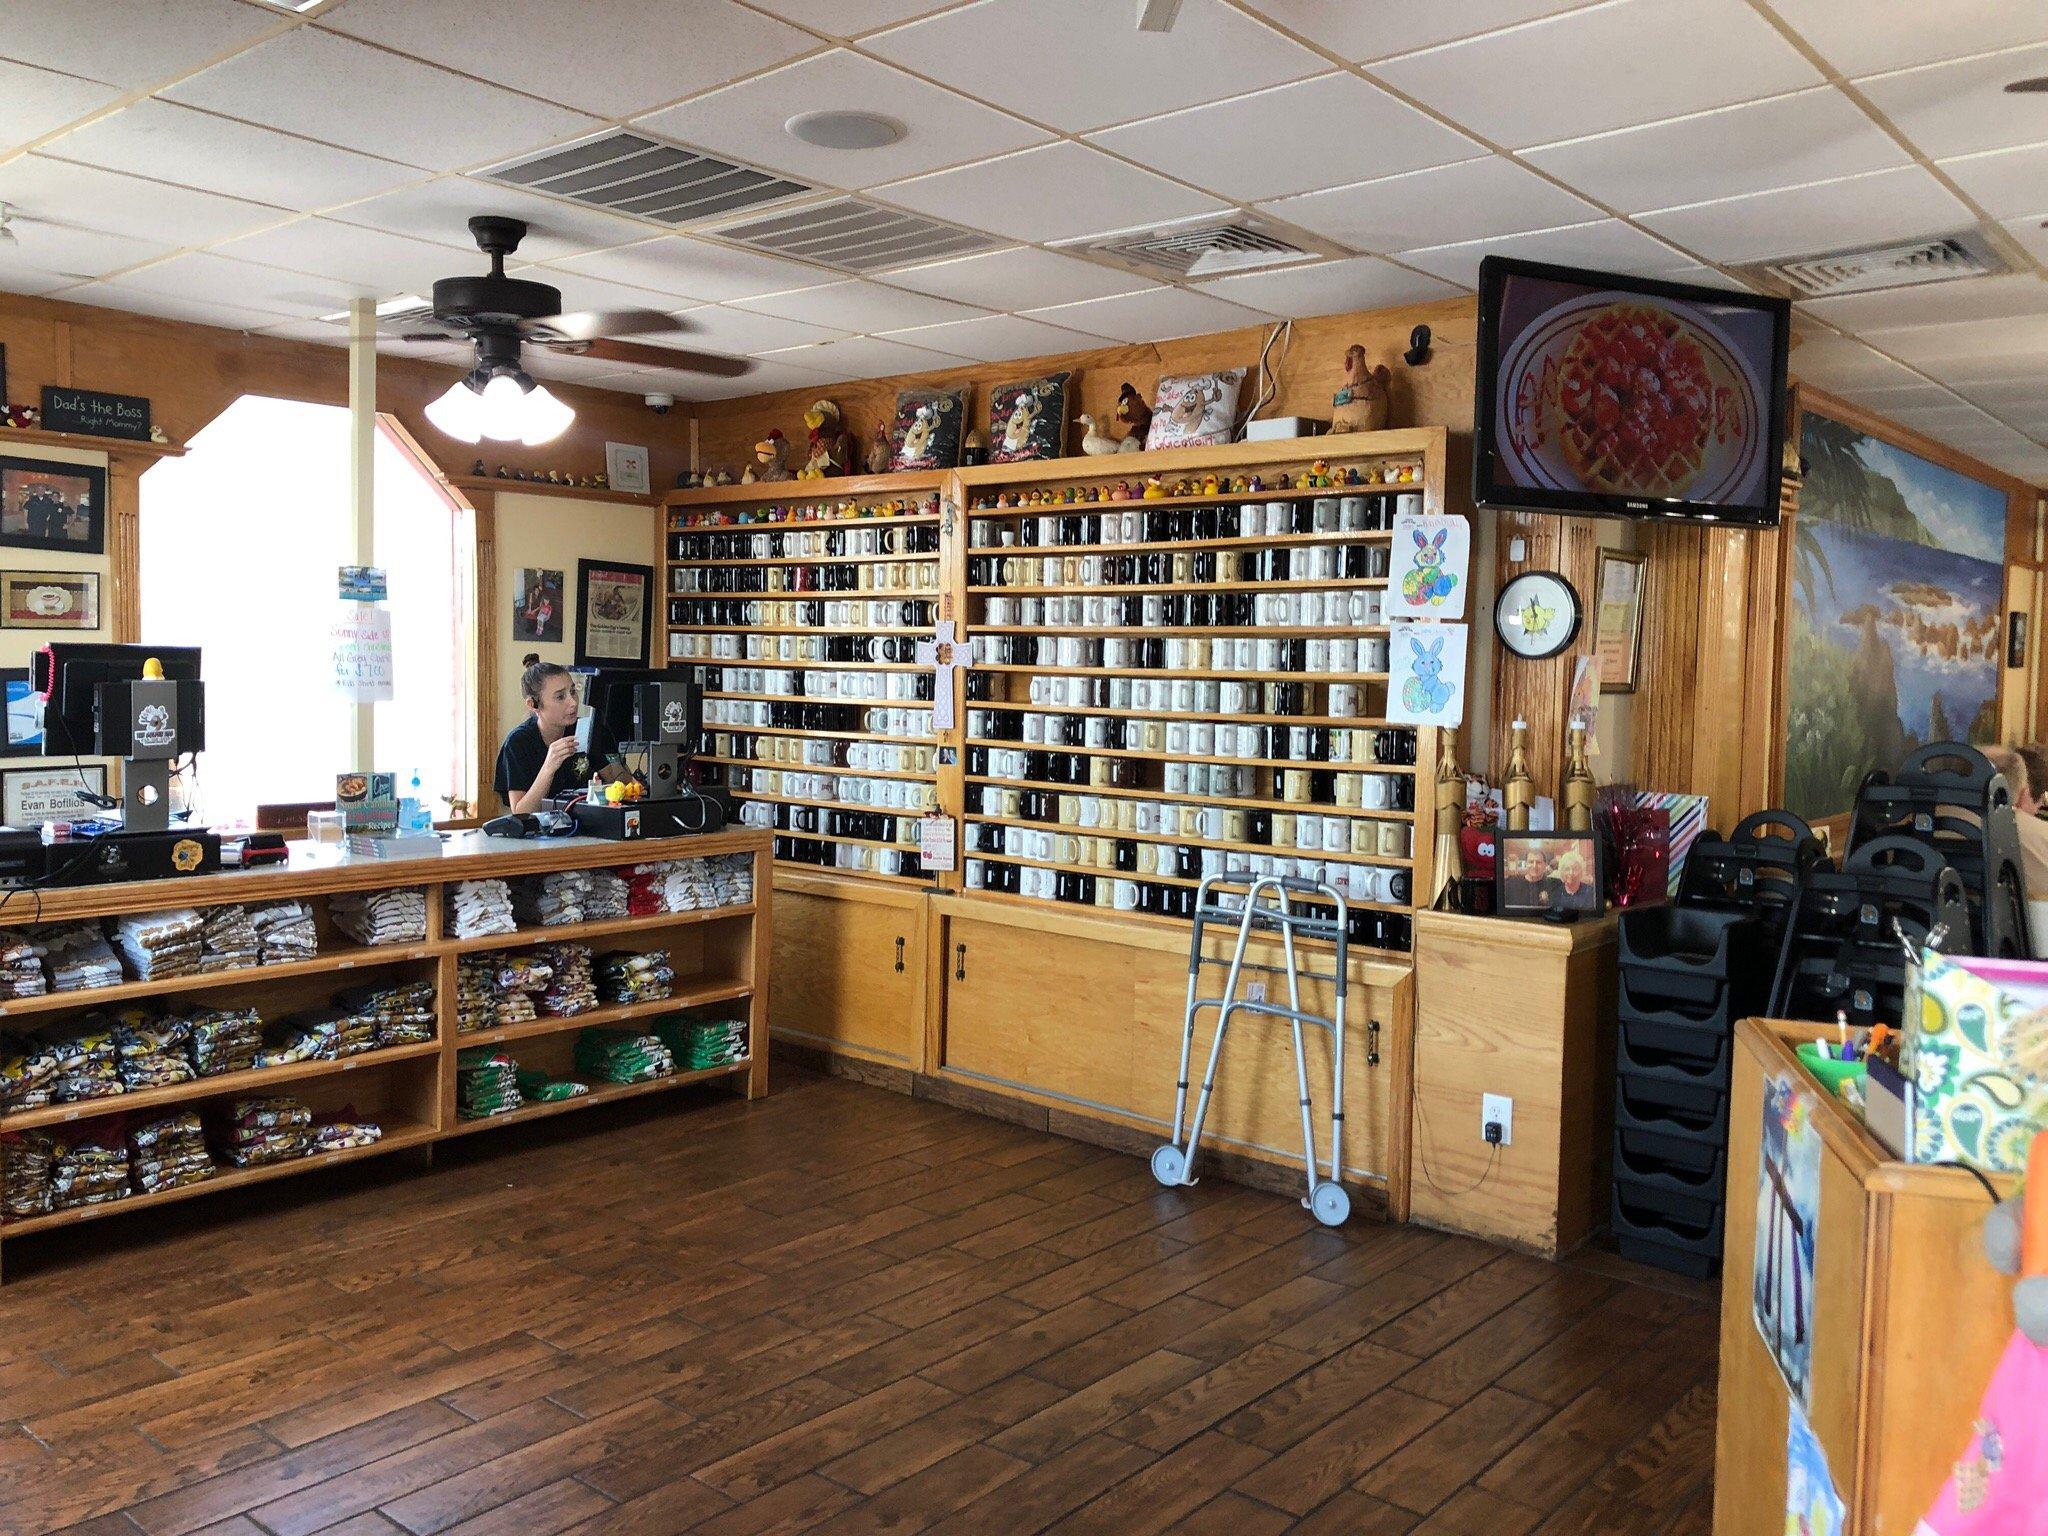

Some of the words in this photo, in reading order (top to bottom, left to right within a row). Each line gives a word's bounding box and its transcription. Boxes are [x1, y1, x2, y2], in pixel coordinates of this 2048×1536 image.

[53, 394, 86, 412] Dad's
[90, 400, 113, 415] the
[116, 402, 142, 418] Boss
[80, 415, 102, 429] Right
[105, 418, 142, 432] Mommy?
[21, 800, 45, 810] Evan
[368, 822, 396, 832] Recipes
